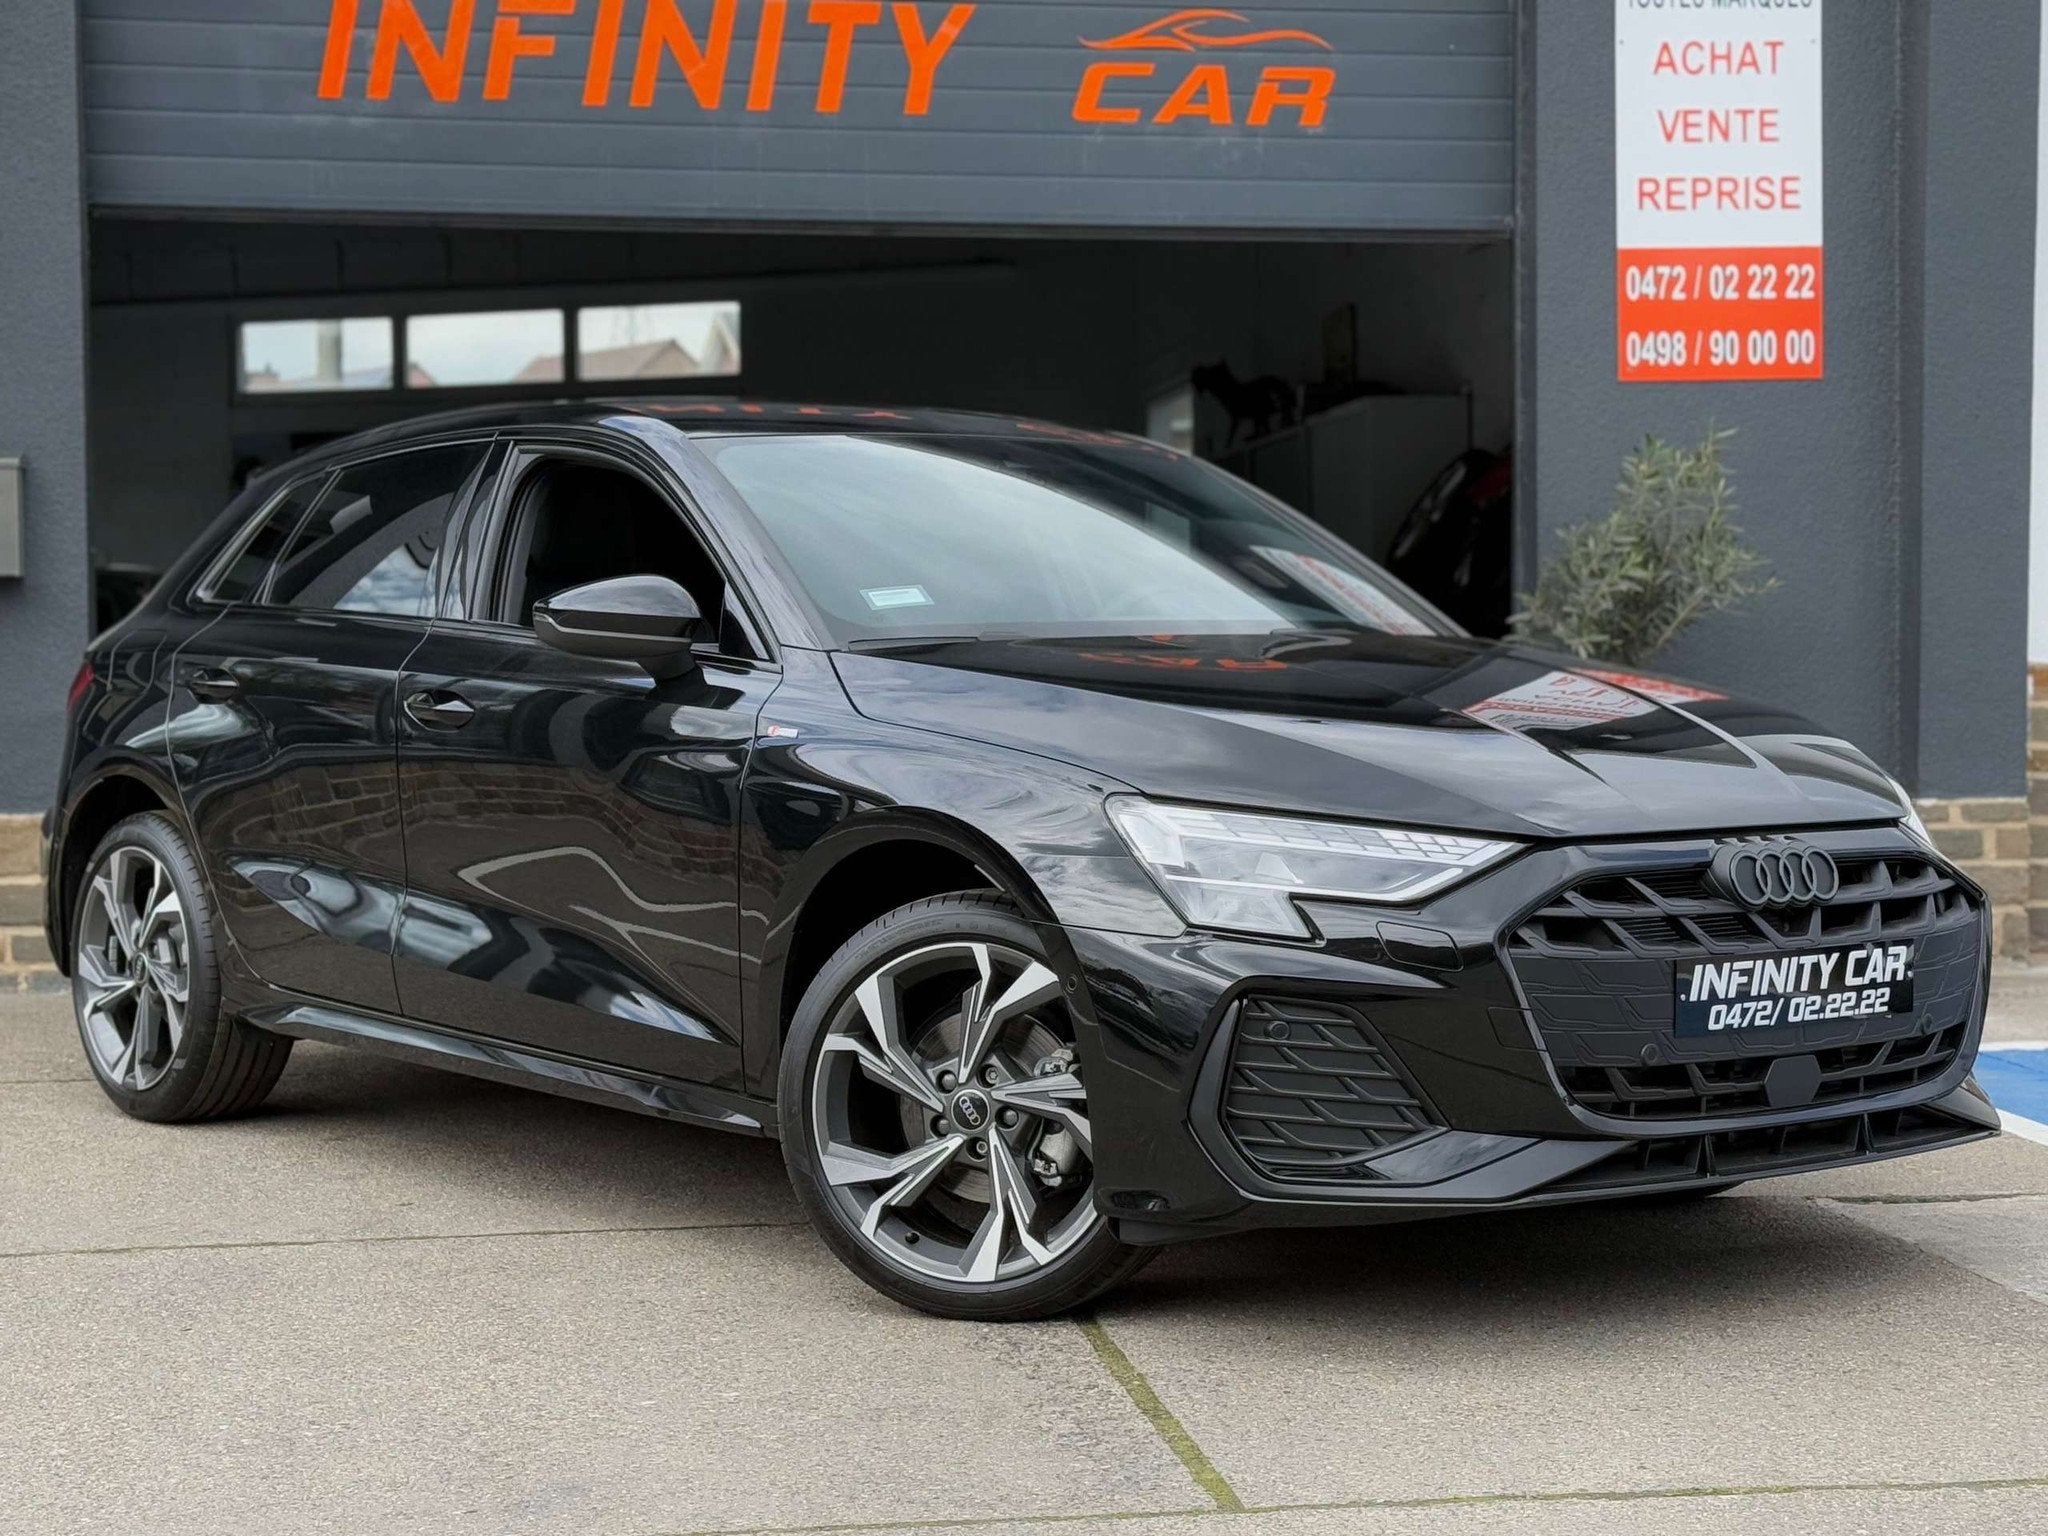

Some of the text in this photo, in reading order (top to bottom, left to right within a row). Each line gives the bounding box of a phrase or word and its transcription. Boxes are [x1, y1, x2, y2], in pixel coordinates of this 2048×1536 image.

[317, 0, 1336, 127] INFINITY CAR
[1653, 40, 1784, 76] ACHAT
[1658, 108, 1779, 144] VENTE
[1637, 175, 1802, 211] REPRISE
[1625, 265, 1687, 301] 0472
[1709, 264, 1740, 300] 02
[1747, 263, 1778, 299] 22
[1785, 263, 1816, 299] 22
[1625, 331, 1687, 367] 0498
[1709, 330, 1740, 366] 90
[1747, 330, 1778, 365] 00
[1785, 329, 1816, 365] 00
[1689, 945, 1908, 1002] INFINITY CAR
[1787, 987, 1891, 1023] 02.22.22
